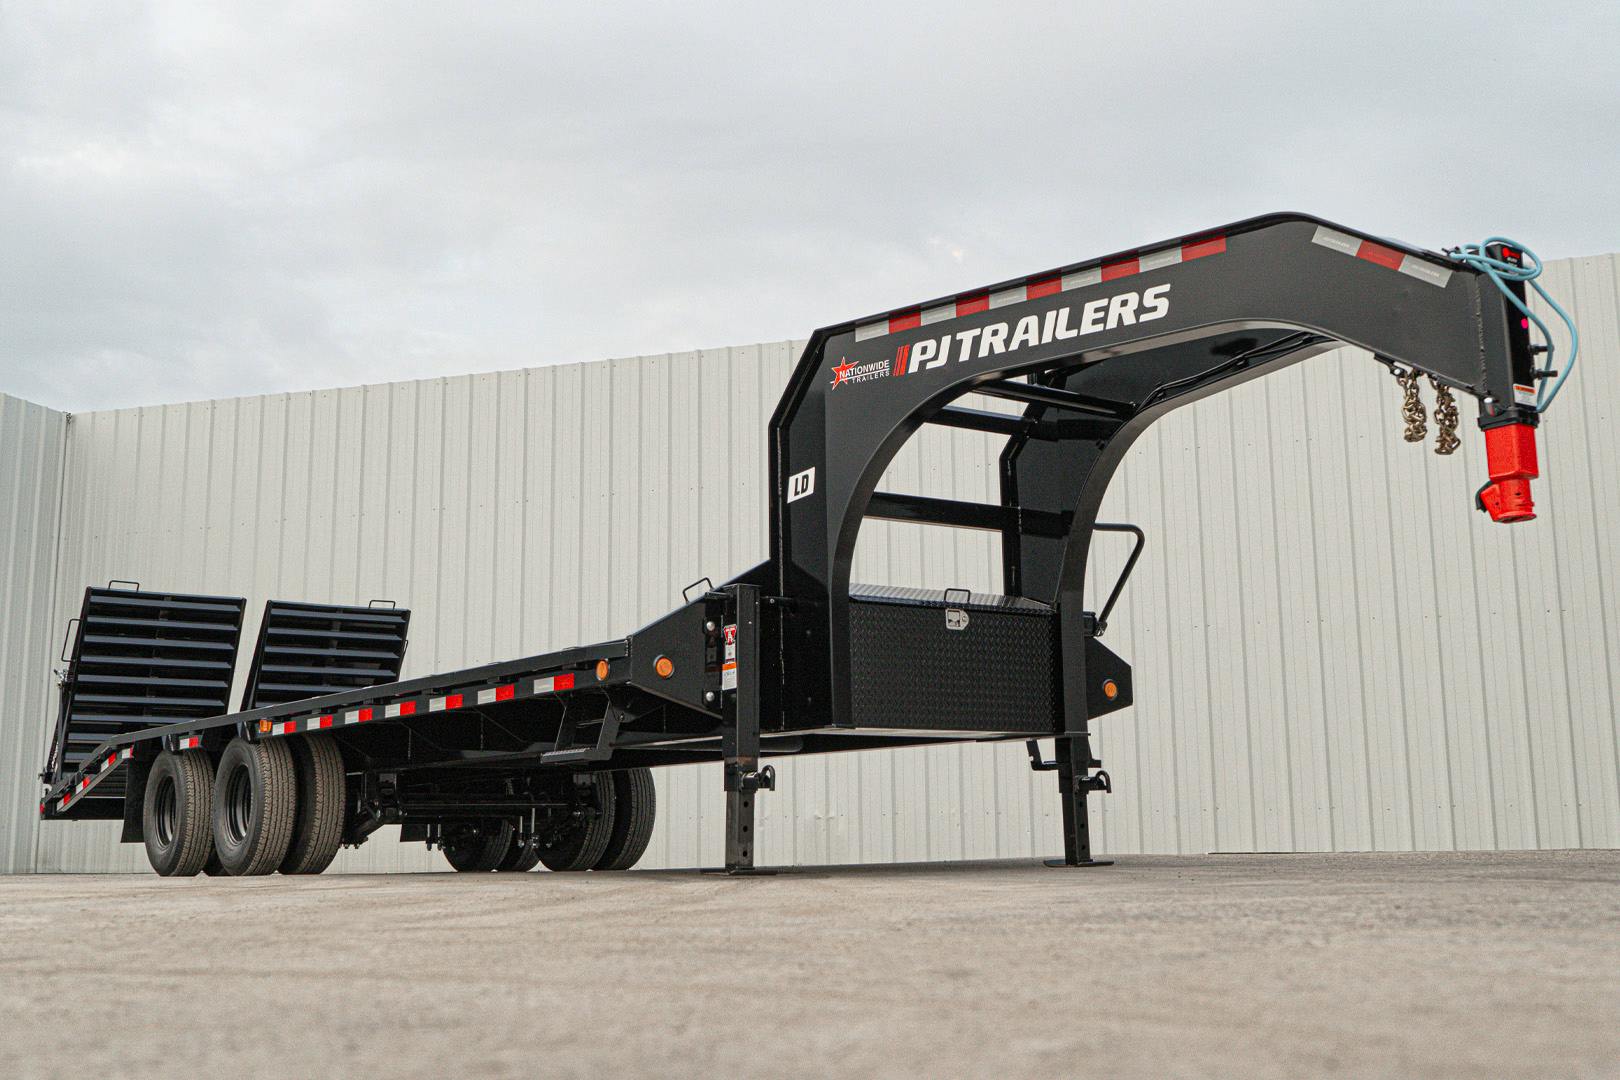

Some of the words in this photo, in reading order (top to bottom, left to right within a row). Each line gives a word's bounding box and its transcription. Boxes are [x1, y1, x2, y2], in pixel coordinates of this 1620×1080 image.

[908, 335, 951, 374] PJ
[956, 283, 1171, 363] TRAILERS
[839, 359, 890, 378] NATIONWIDE
[851, 371, 890, 384] TRAILERS
[794, 473, 809, 497] LD
